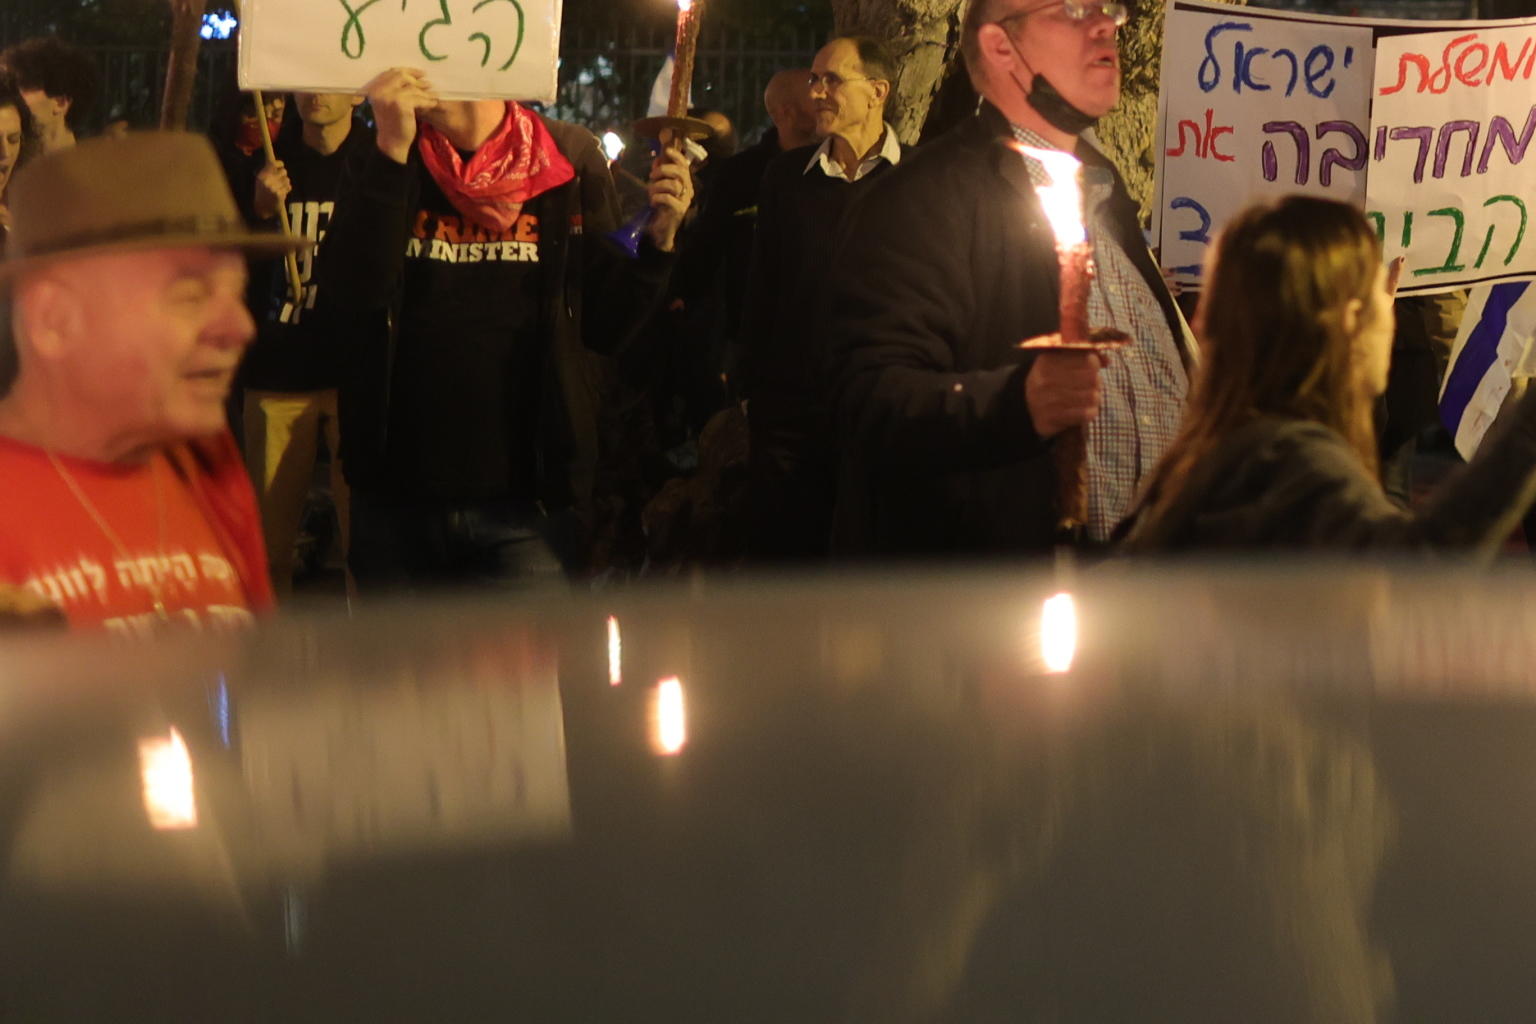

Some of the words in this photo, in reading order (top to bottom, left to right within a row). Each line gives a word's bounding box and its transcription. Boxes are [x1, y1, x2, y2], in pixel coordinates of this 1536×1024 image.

[1197, 21, 1355, 99] ישראל
[1166, 107, 1236, 163] את
[404, 237, 541, 264] MINISTER
